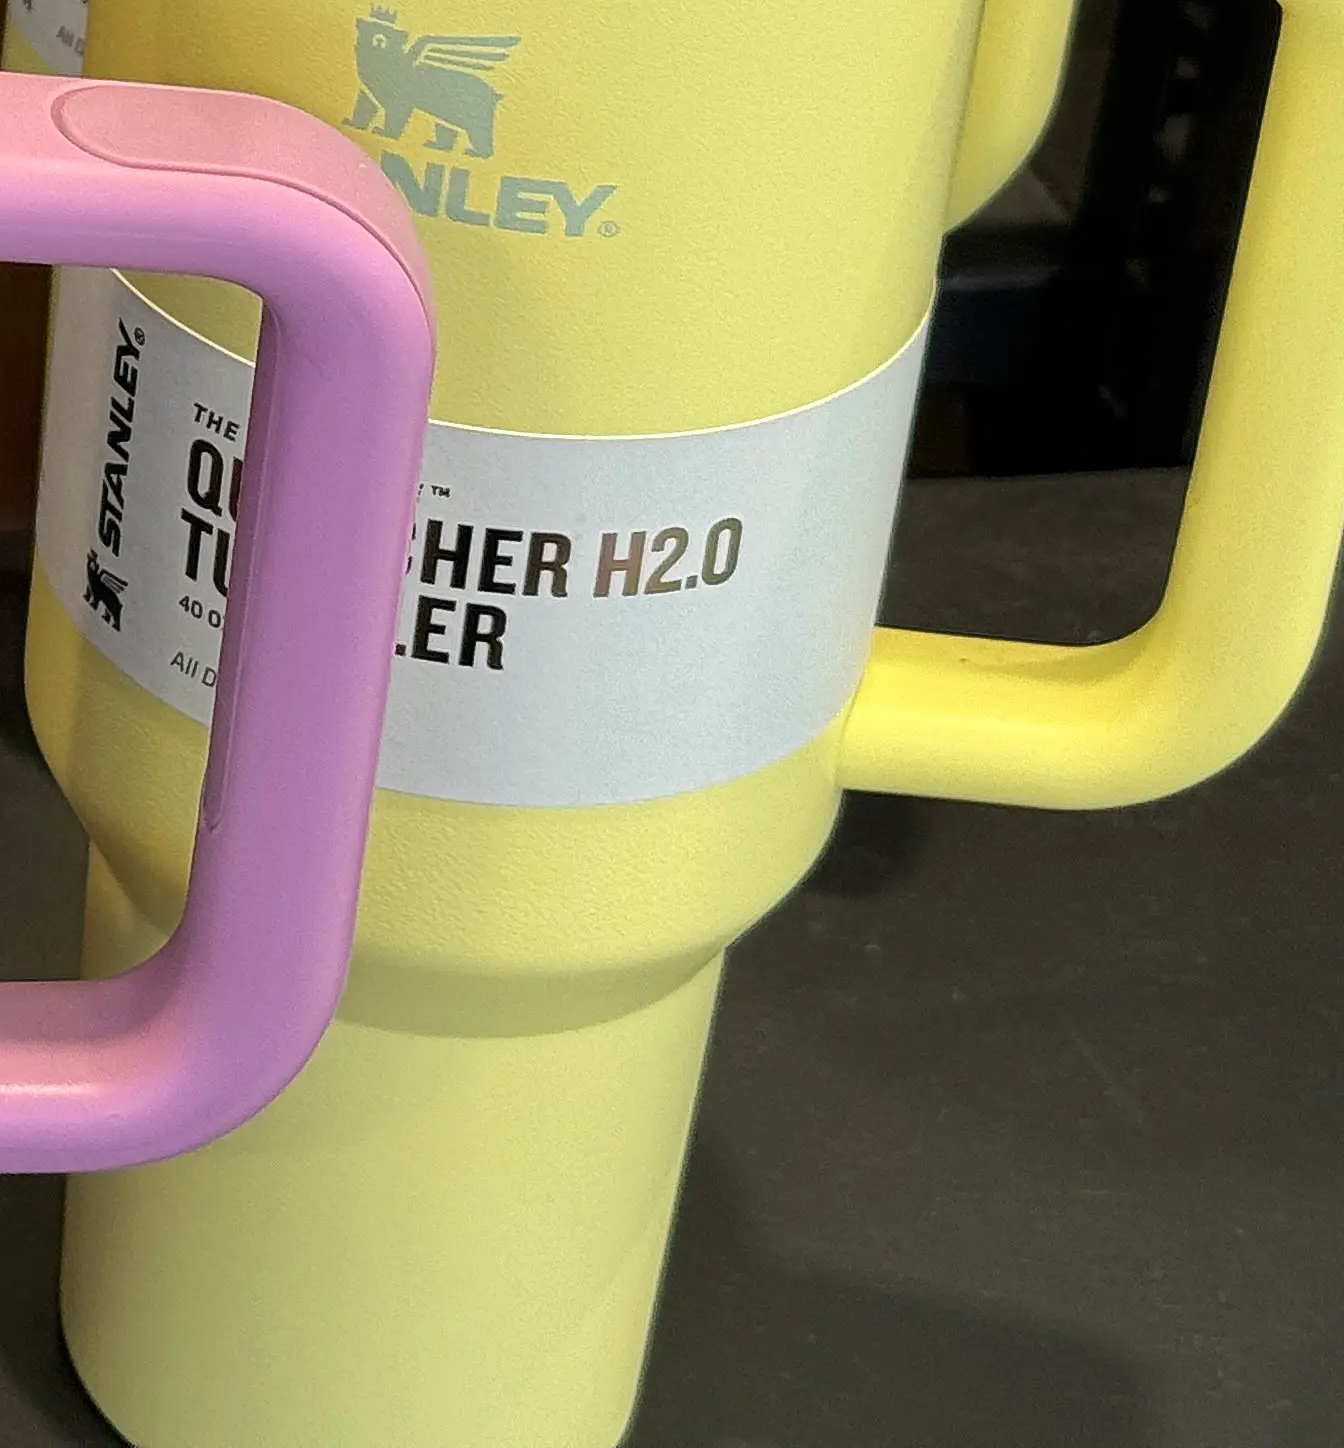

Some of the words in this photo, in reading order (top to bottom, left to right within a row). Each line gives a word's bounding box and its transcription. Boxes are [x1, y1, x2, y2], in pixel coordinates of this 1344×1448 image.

[193, 402, 240, 442] THE
[593, 516, 743, 598] H2.0
[179, 595, 203, 619] 40
[170, 651, 199, 679] All
